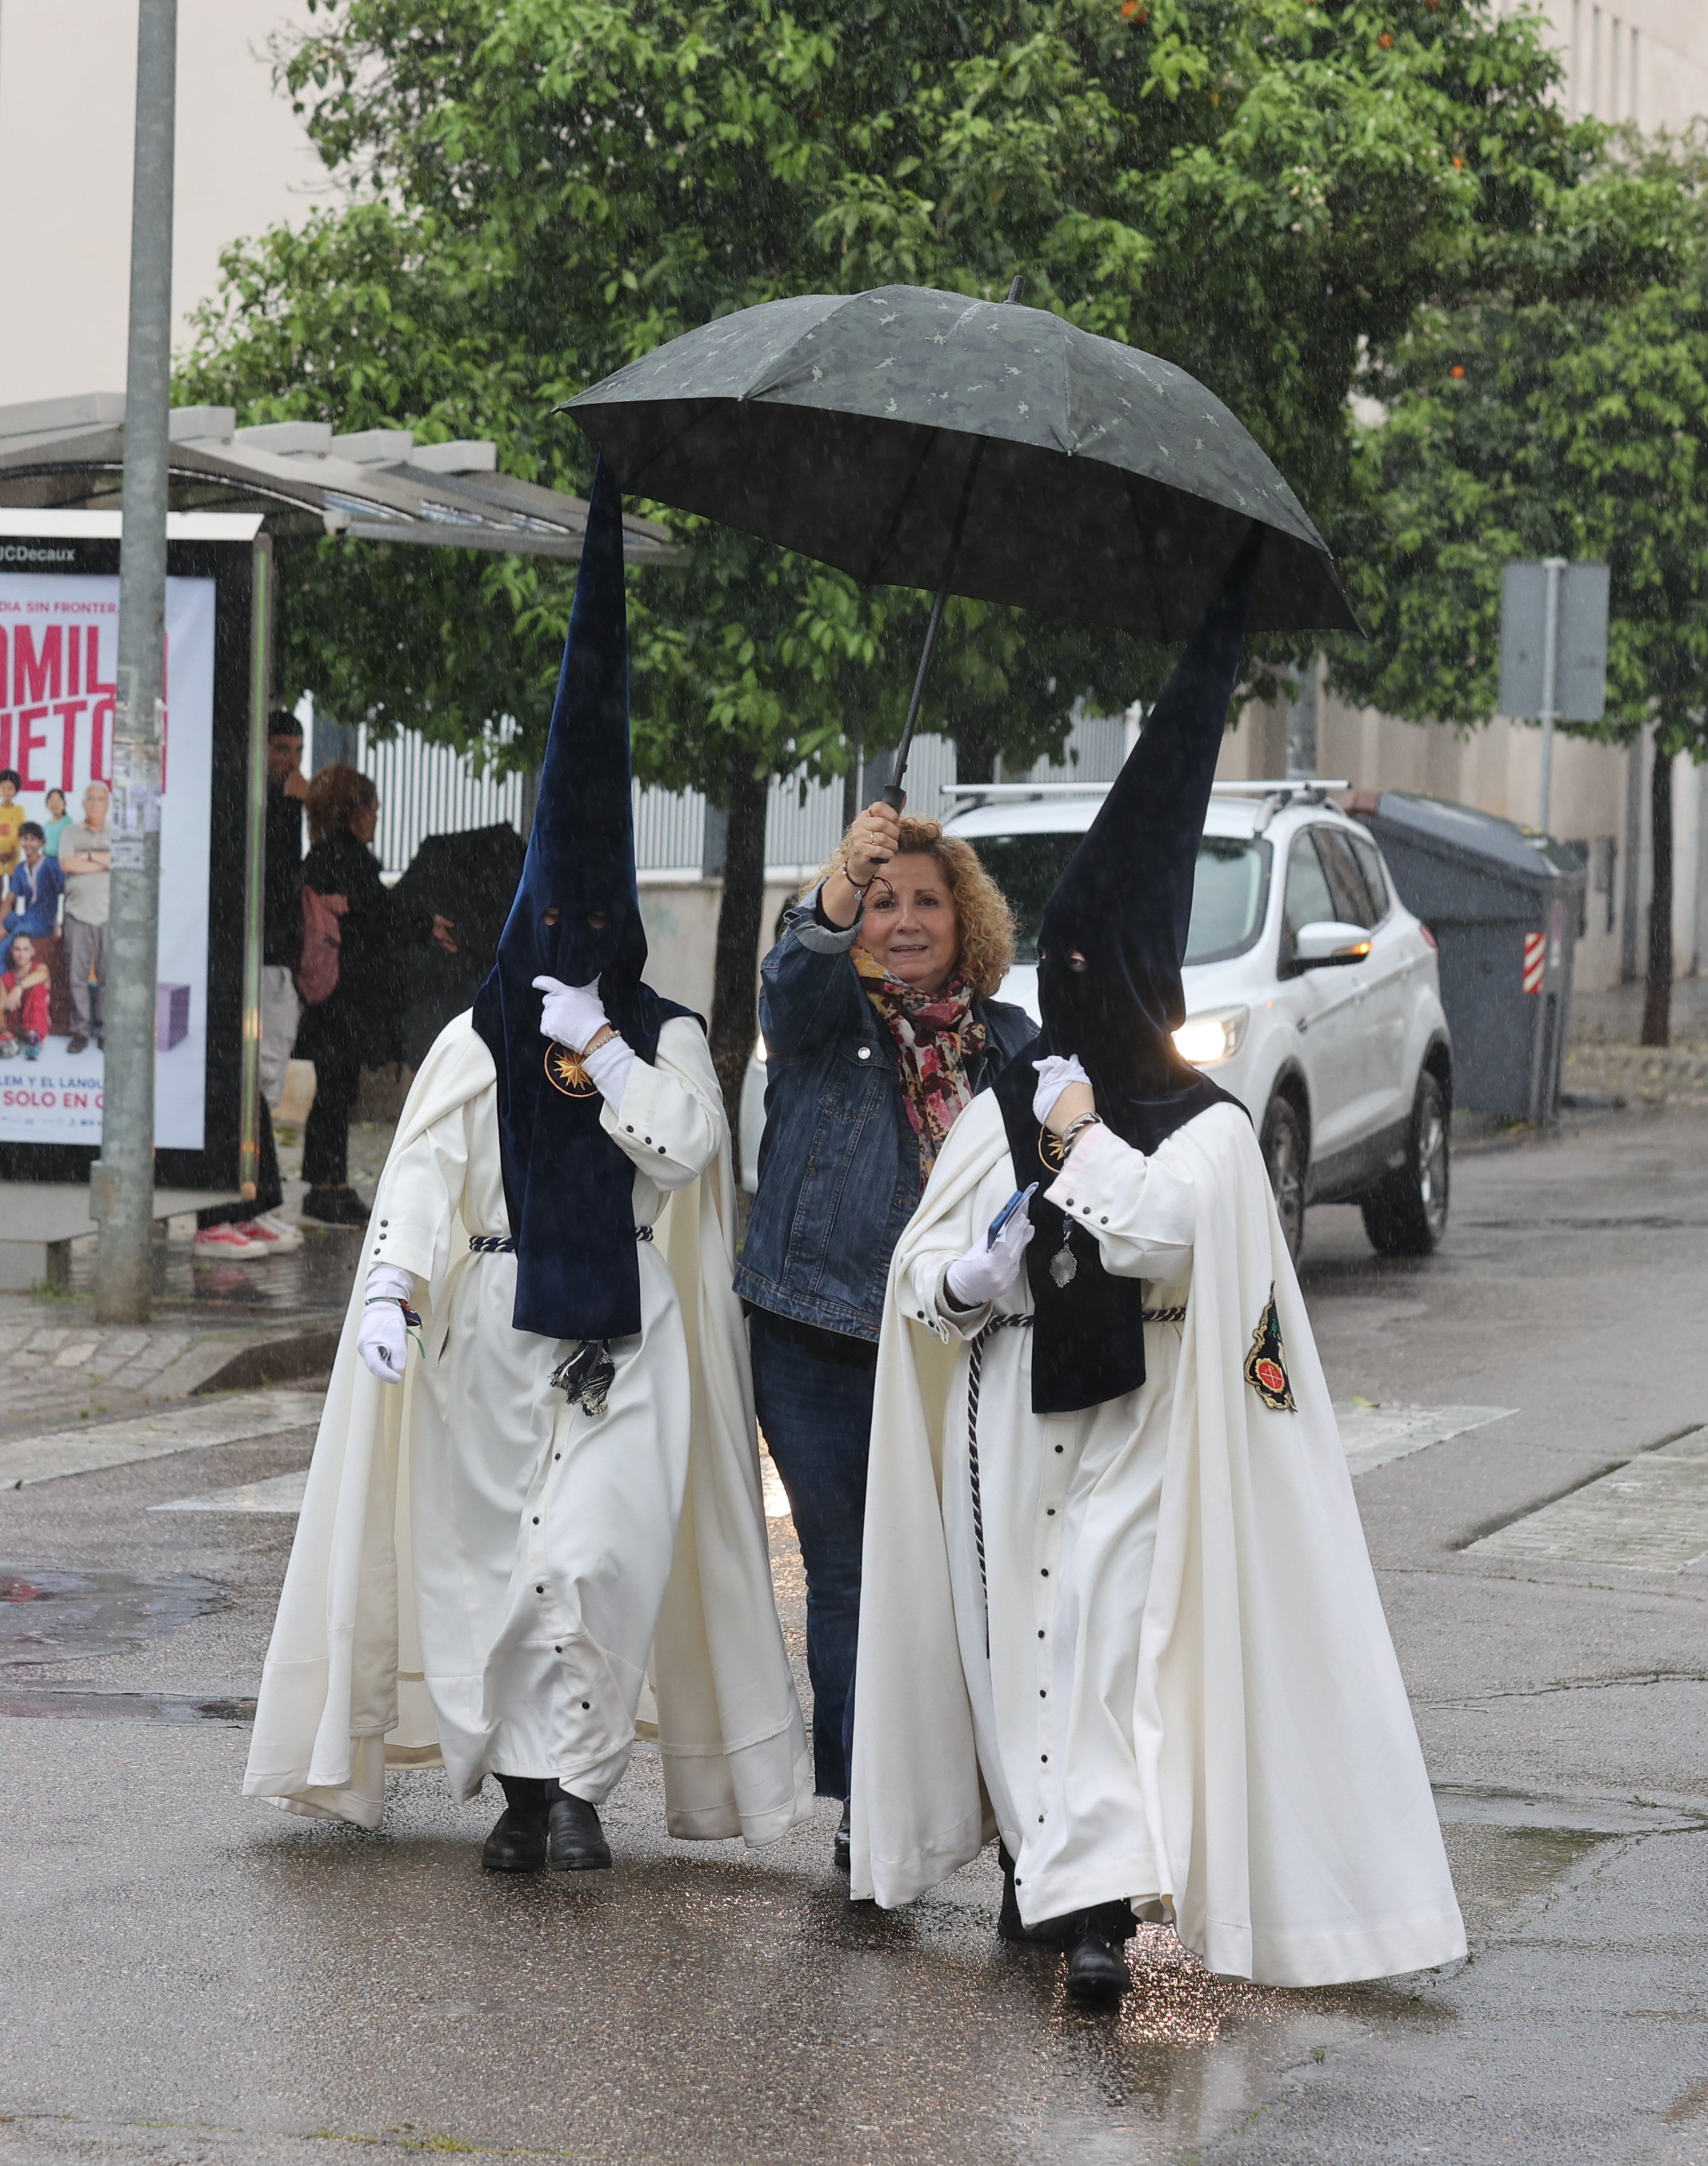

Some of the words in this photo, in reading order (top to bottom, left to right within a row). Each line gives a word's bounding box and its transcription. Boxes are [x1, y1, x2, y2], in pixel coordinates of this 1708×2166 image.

[27, 601, 49, 613] SIN
[54, 601, 119, 615] FRONTER
[29, 1075, 36, 1087] Y
[42, 1076, 54, 1087] EL
[4, 1090, 55, 1108] SOLO
[63, 1093, 88, 1109] EN
